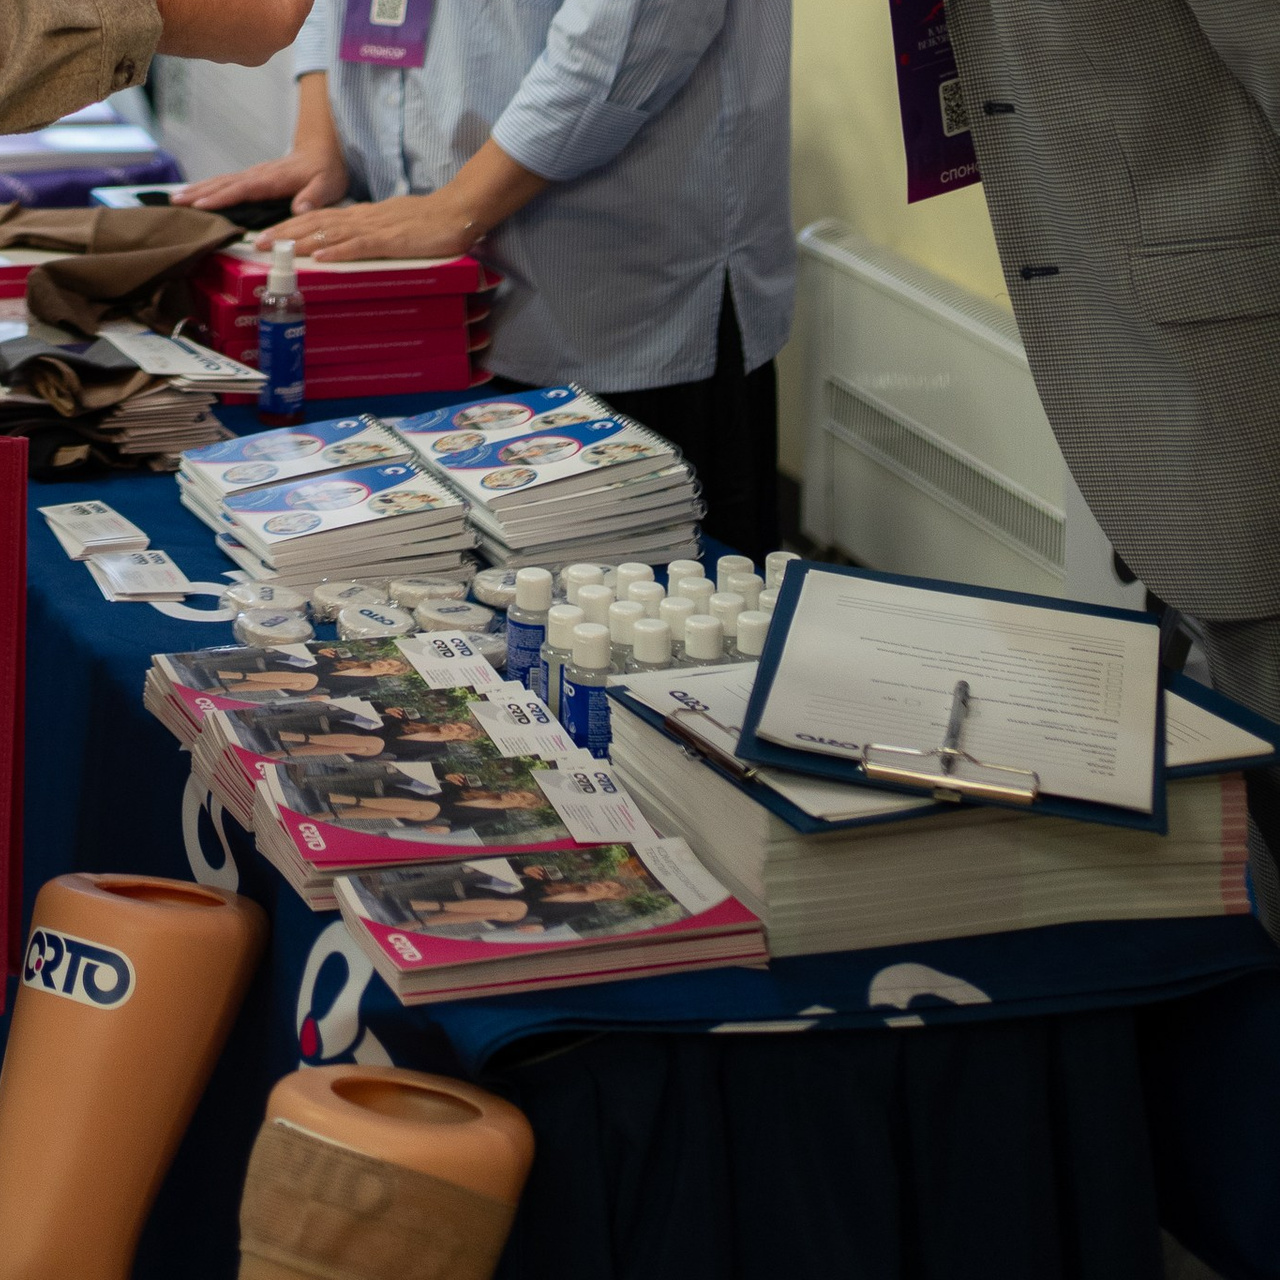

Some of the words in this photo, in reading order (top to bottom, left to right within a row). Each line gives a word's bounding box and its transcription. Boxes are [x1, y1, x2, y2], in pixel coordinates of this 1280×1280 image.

[359, 609, 395, 626] ORTO
[433, 639, 455, 658] ORTO
[450, 637, 473, 657] ORTO
[669, 690, 710, 711] ORTO
[508, 703, 530, 725] ORTO
[526, 702, 550, 724] ORTO
[795, 732, 859, 750] ORTO
[573, 773, 597, 793] ORTO
[594, 771, 617, 793] ORTO
[298, 822, 326, 852] ORTO
[387, 932, 422, 962] ORTO
[24, 928, 132, 1006] ORTO
